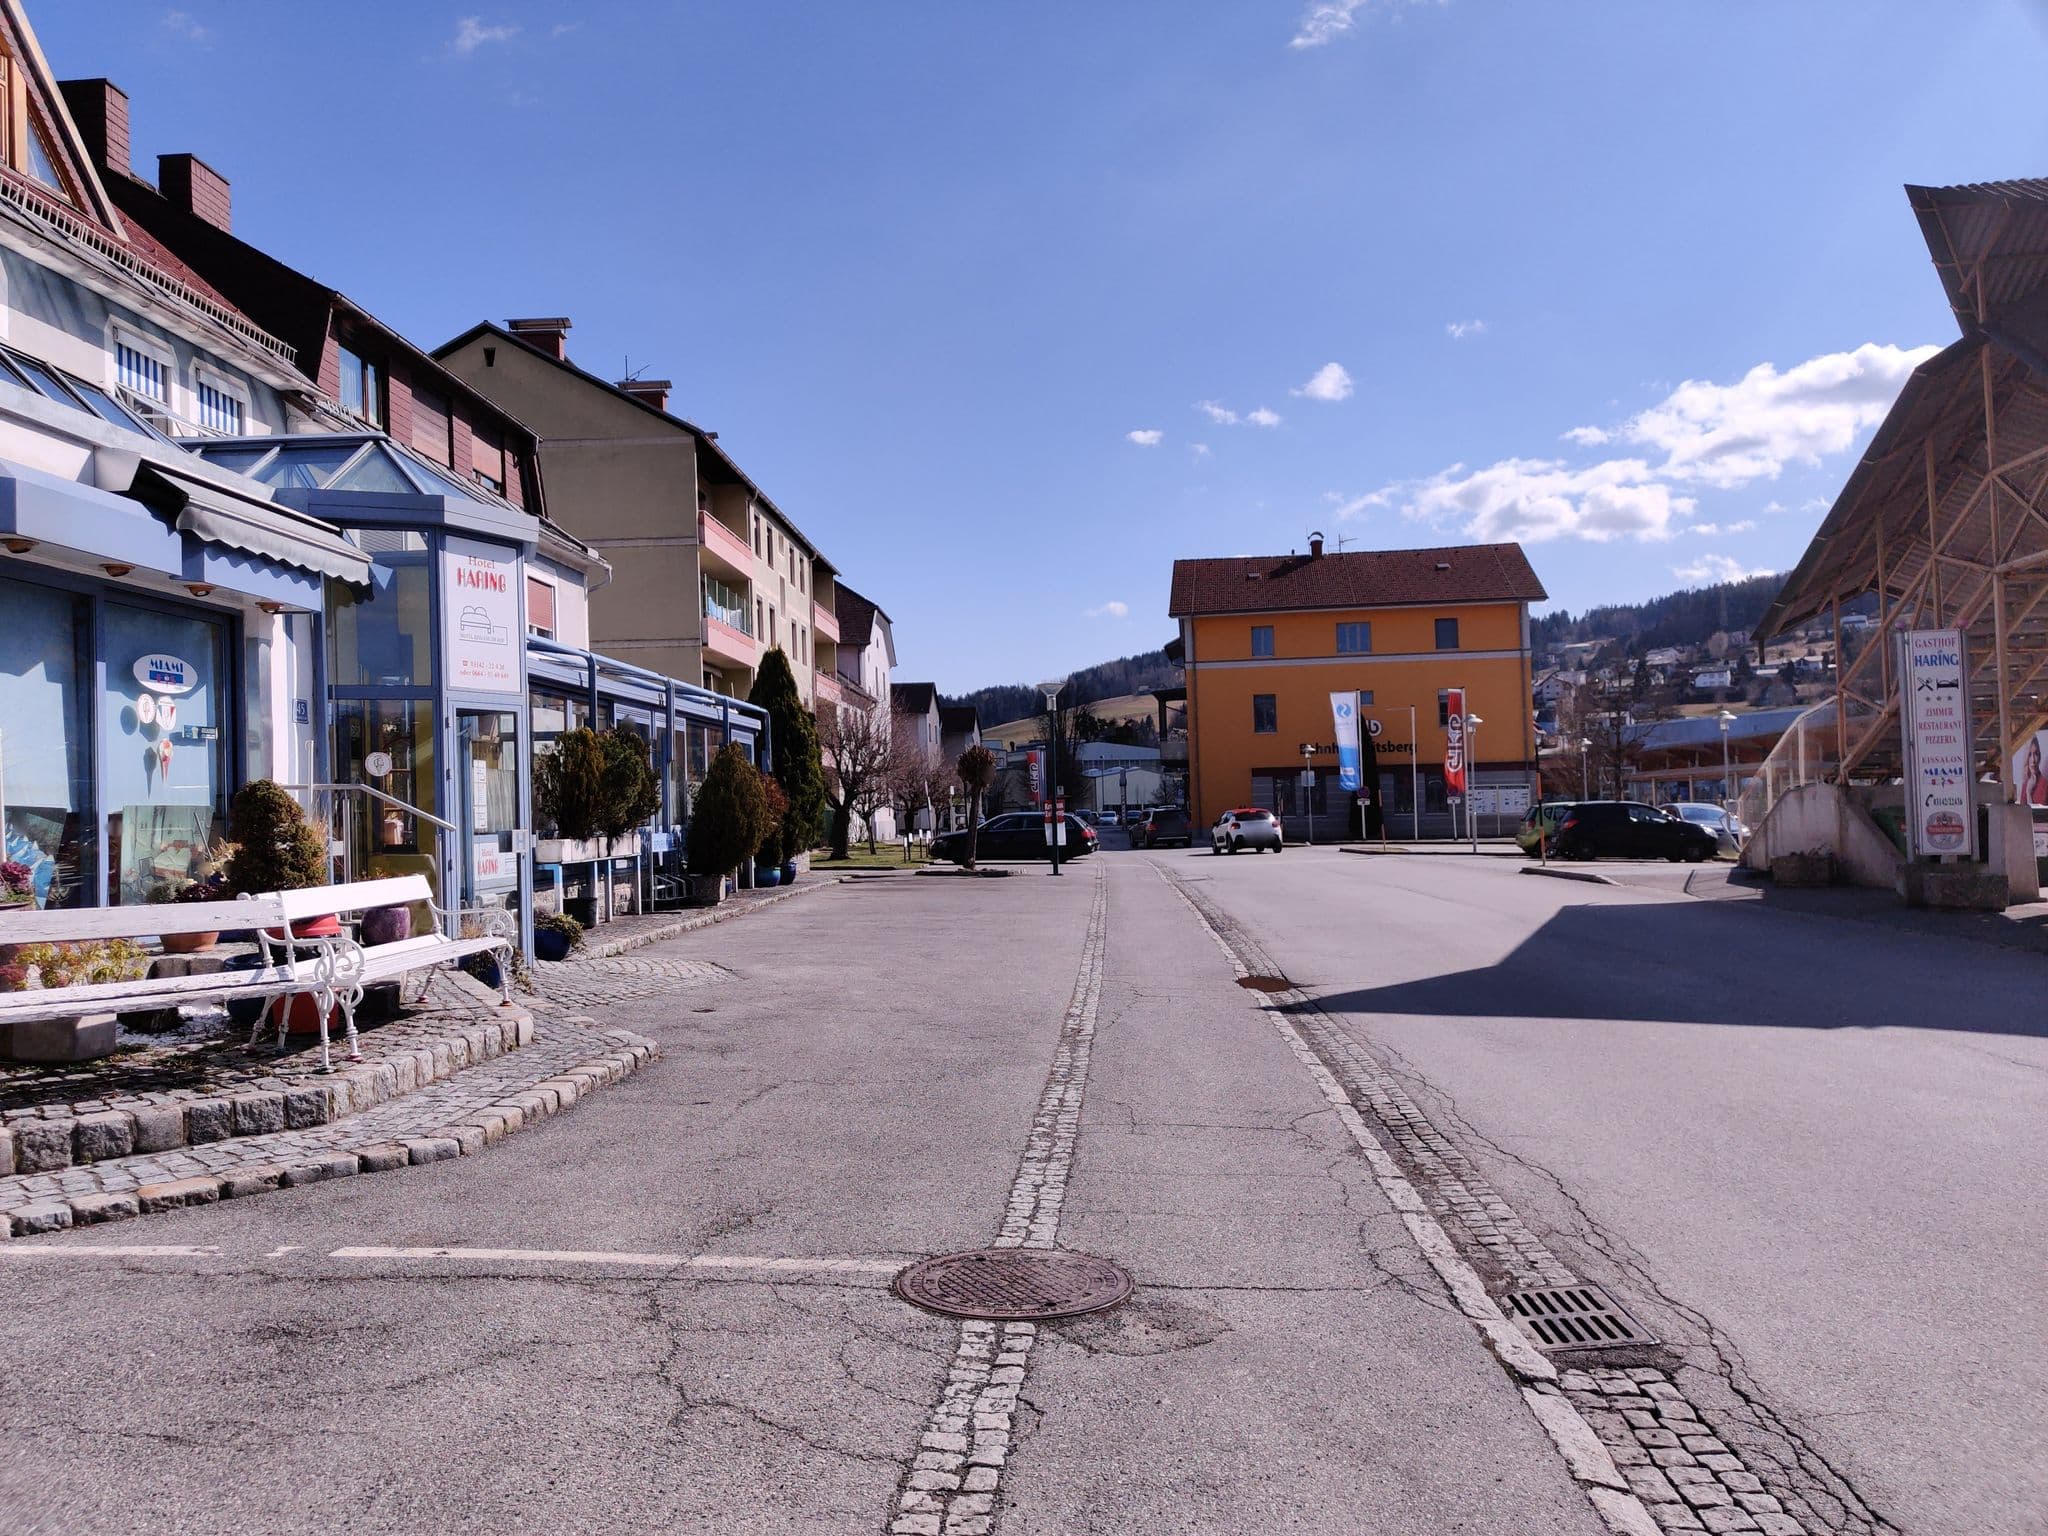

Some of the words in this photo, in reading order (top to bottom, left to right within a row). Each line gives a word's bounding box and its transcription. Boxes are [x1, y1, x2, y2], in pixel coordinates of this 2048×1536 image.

[469, 556, 495, 569] Hotel
[457, 567, 506, 593] HARING
[1915, 637, 1957, 649] GASTHOF
[1914, 652, 1960, 667] HARING
[150, 658, 184, 673] MIAMI
[1926, 707, 1954, 717] ZIMMER
[1918, 720, 1962, 731] RESTAURANT
[1925, 735, 1957, 745] PIZZERIA
[1921, 755, 1963, 764] EISSALON
[1924, 767, 1963, 776] MIAMI
